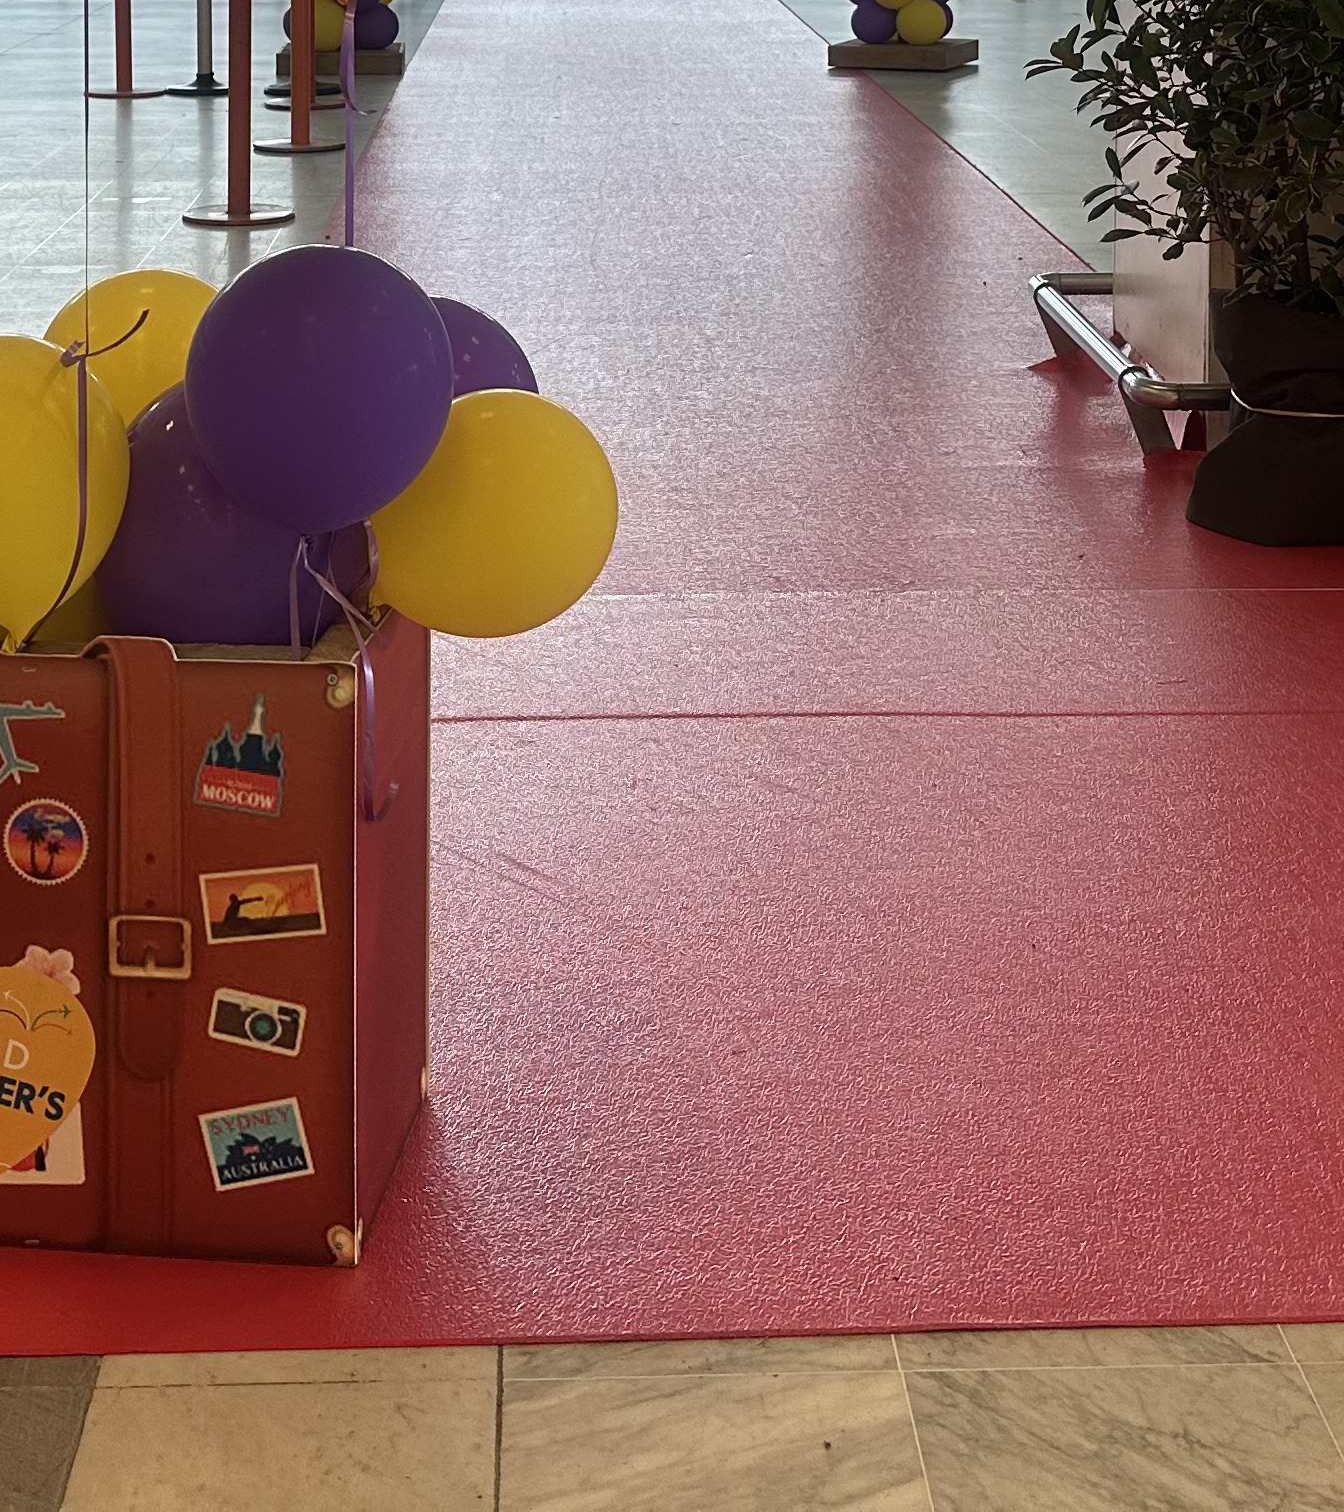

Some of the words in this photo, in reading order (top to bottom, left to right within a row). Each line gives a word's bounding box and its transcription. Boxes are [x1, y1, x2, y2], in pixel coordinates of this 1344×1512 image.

[202, 783, 275, 809] MOSCOW
[209, 1106, 290, 1136] SYDNEY
[222, 1155, 304, 1181] AUSTRALIA
